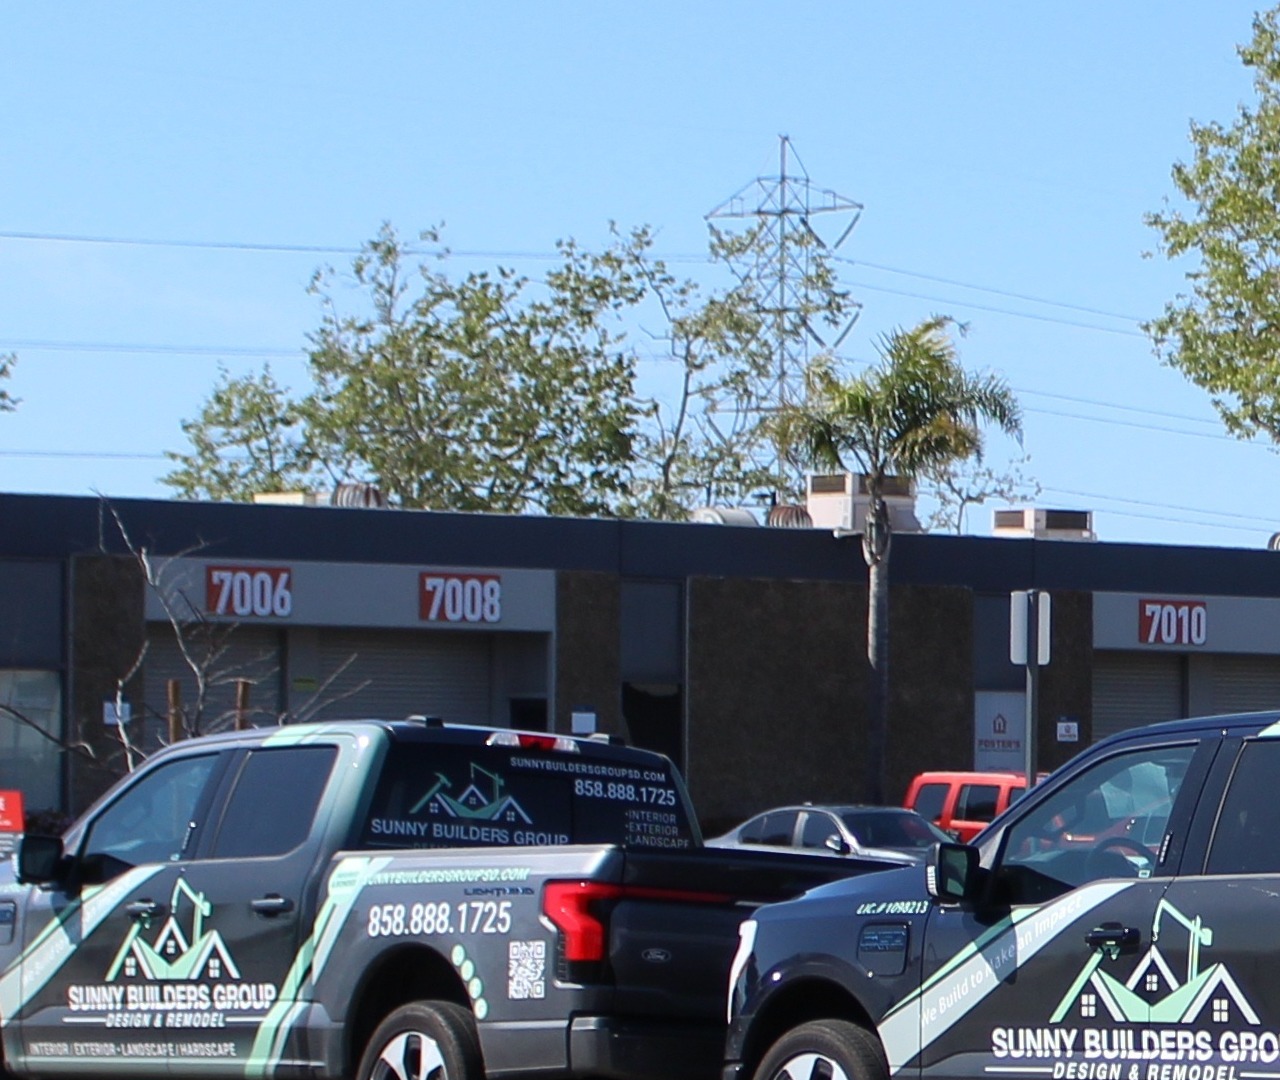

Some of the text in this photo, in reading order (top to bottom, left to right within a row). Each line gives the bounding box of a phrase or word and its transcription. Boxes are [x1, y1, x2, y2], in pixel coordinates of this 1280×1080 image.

[212, 571, 291, 616] 7006
[425, 576, 501, 622] 7008
[1145, 604, 1206, 645] 7010
[510, 757, 665, 782] SUNNYBUILDERSGROUPSD.COM
[574, 779, 675, 806] 858.888.1725
[629, 810, 676, 824] INTERIOR
[629, 823, 678, 836] EXTERIOR
[371, 819, 568, 846] SUNNY BUILDERS GROUP
[368, 901, 512, 937] 858.888.1725
[938, 979, 969, 1013] Build
[970, 970, 983, 989] to
[1017, 933, 1033, 950] an
[1034, 895, 1083, 937] Impact
[68, 985, 277, 1010] SUNNY BUILDERS GROUP
[105, 1013, 150, 1028] DESIGN
[165, 1013, 226, 1027] REMODEL
[991, 1027, 1077, 1058] SUNNY
[1084, 1029, 1213, 1062] BUILDERS
[1053, 1062, 1121, 1080] DESIGN
